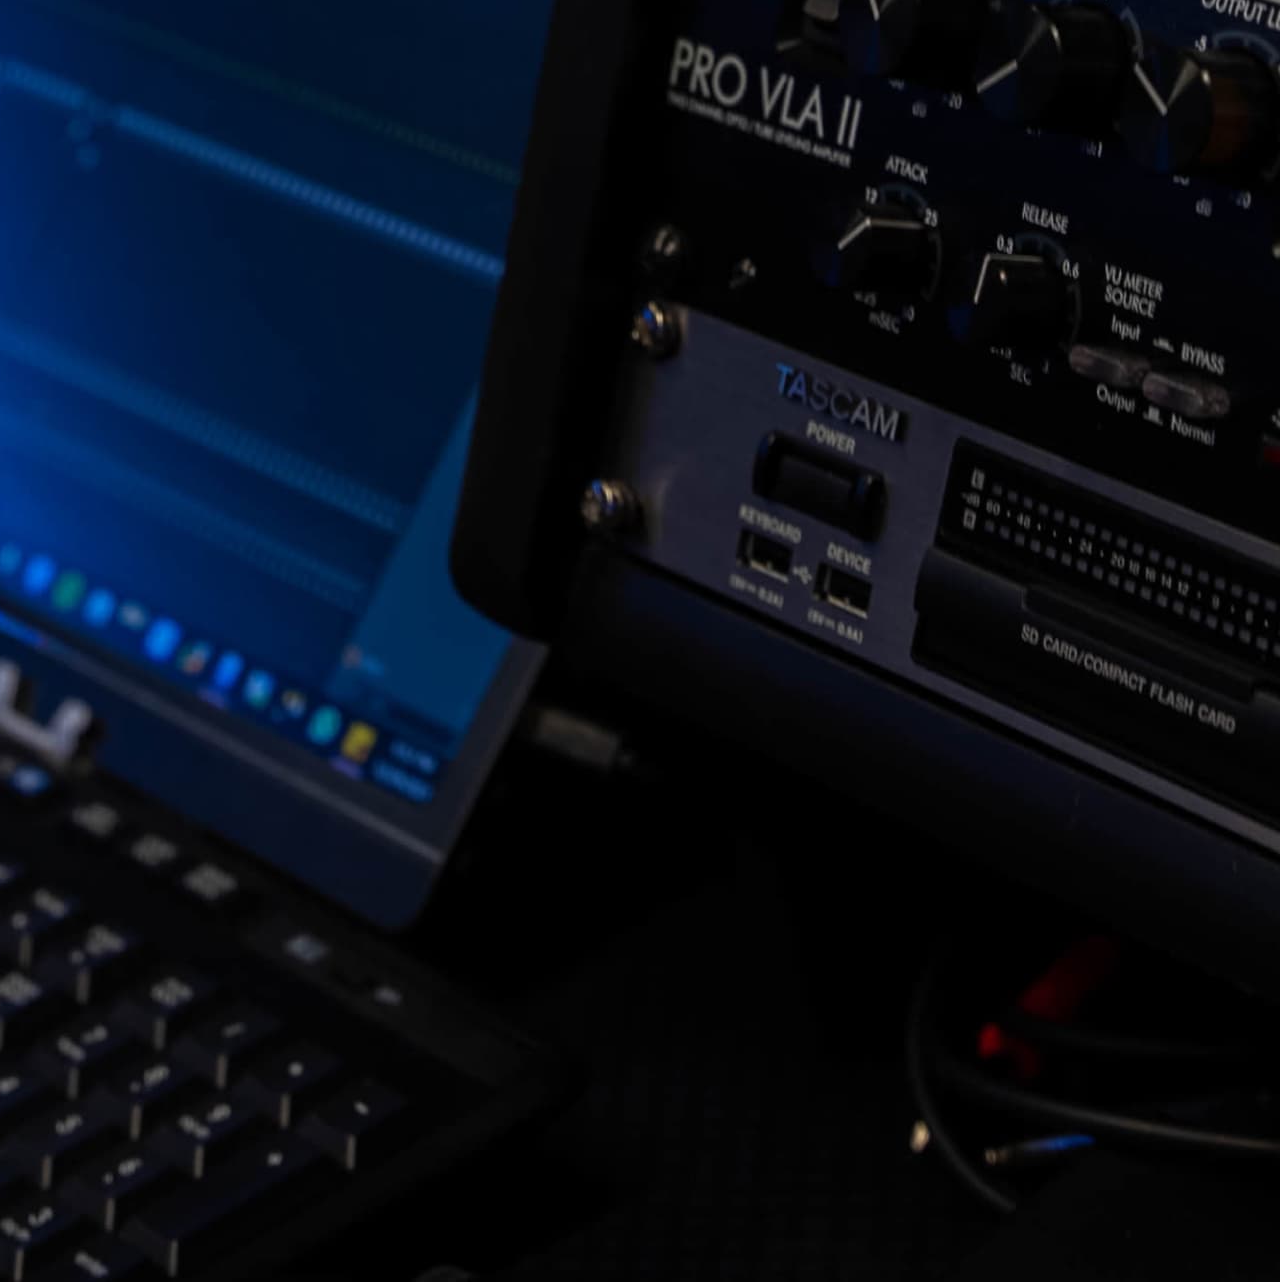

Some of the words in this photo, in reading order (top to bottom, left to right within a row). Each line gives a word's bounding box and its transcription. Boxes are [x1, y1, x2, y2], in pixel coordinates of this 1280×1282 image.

[669, 34, 749, 108] PRO
[760, 64, 825, 140] VLA
[836, 94, 863, 151] II
[884, 154, 929, 186] ATTACK
[1021, 201, 1070, 236] RELEASE
[1104, 261, 1123, 287] VU
[1123, 271, 1164, 303] METER
[1104, 283, 1157, 319] SOURCE
[1180, 341, 1226, 377] BYPASS
[776, 362, 900, 442] TASCAM
[805, 418, 857, 455] POWER
[1170, 413, 1216, 447] Normal
[826, 541, 872, 577] DEVICE
[1020, 623, 1040, 647] SD
[1149, 682, 1195, 717] FLASH
[1197, 703, 1236, 735] CARD
